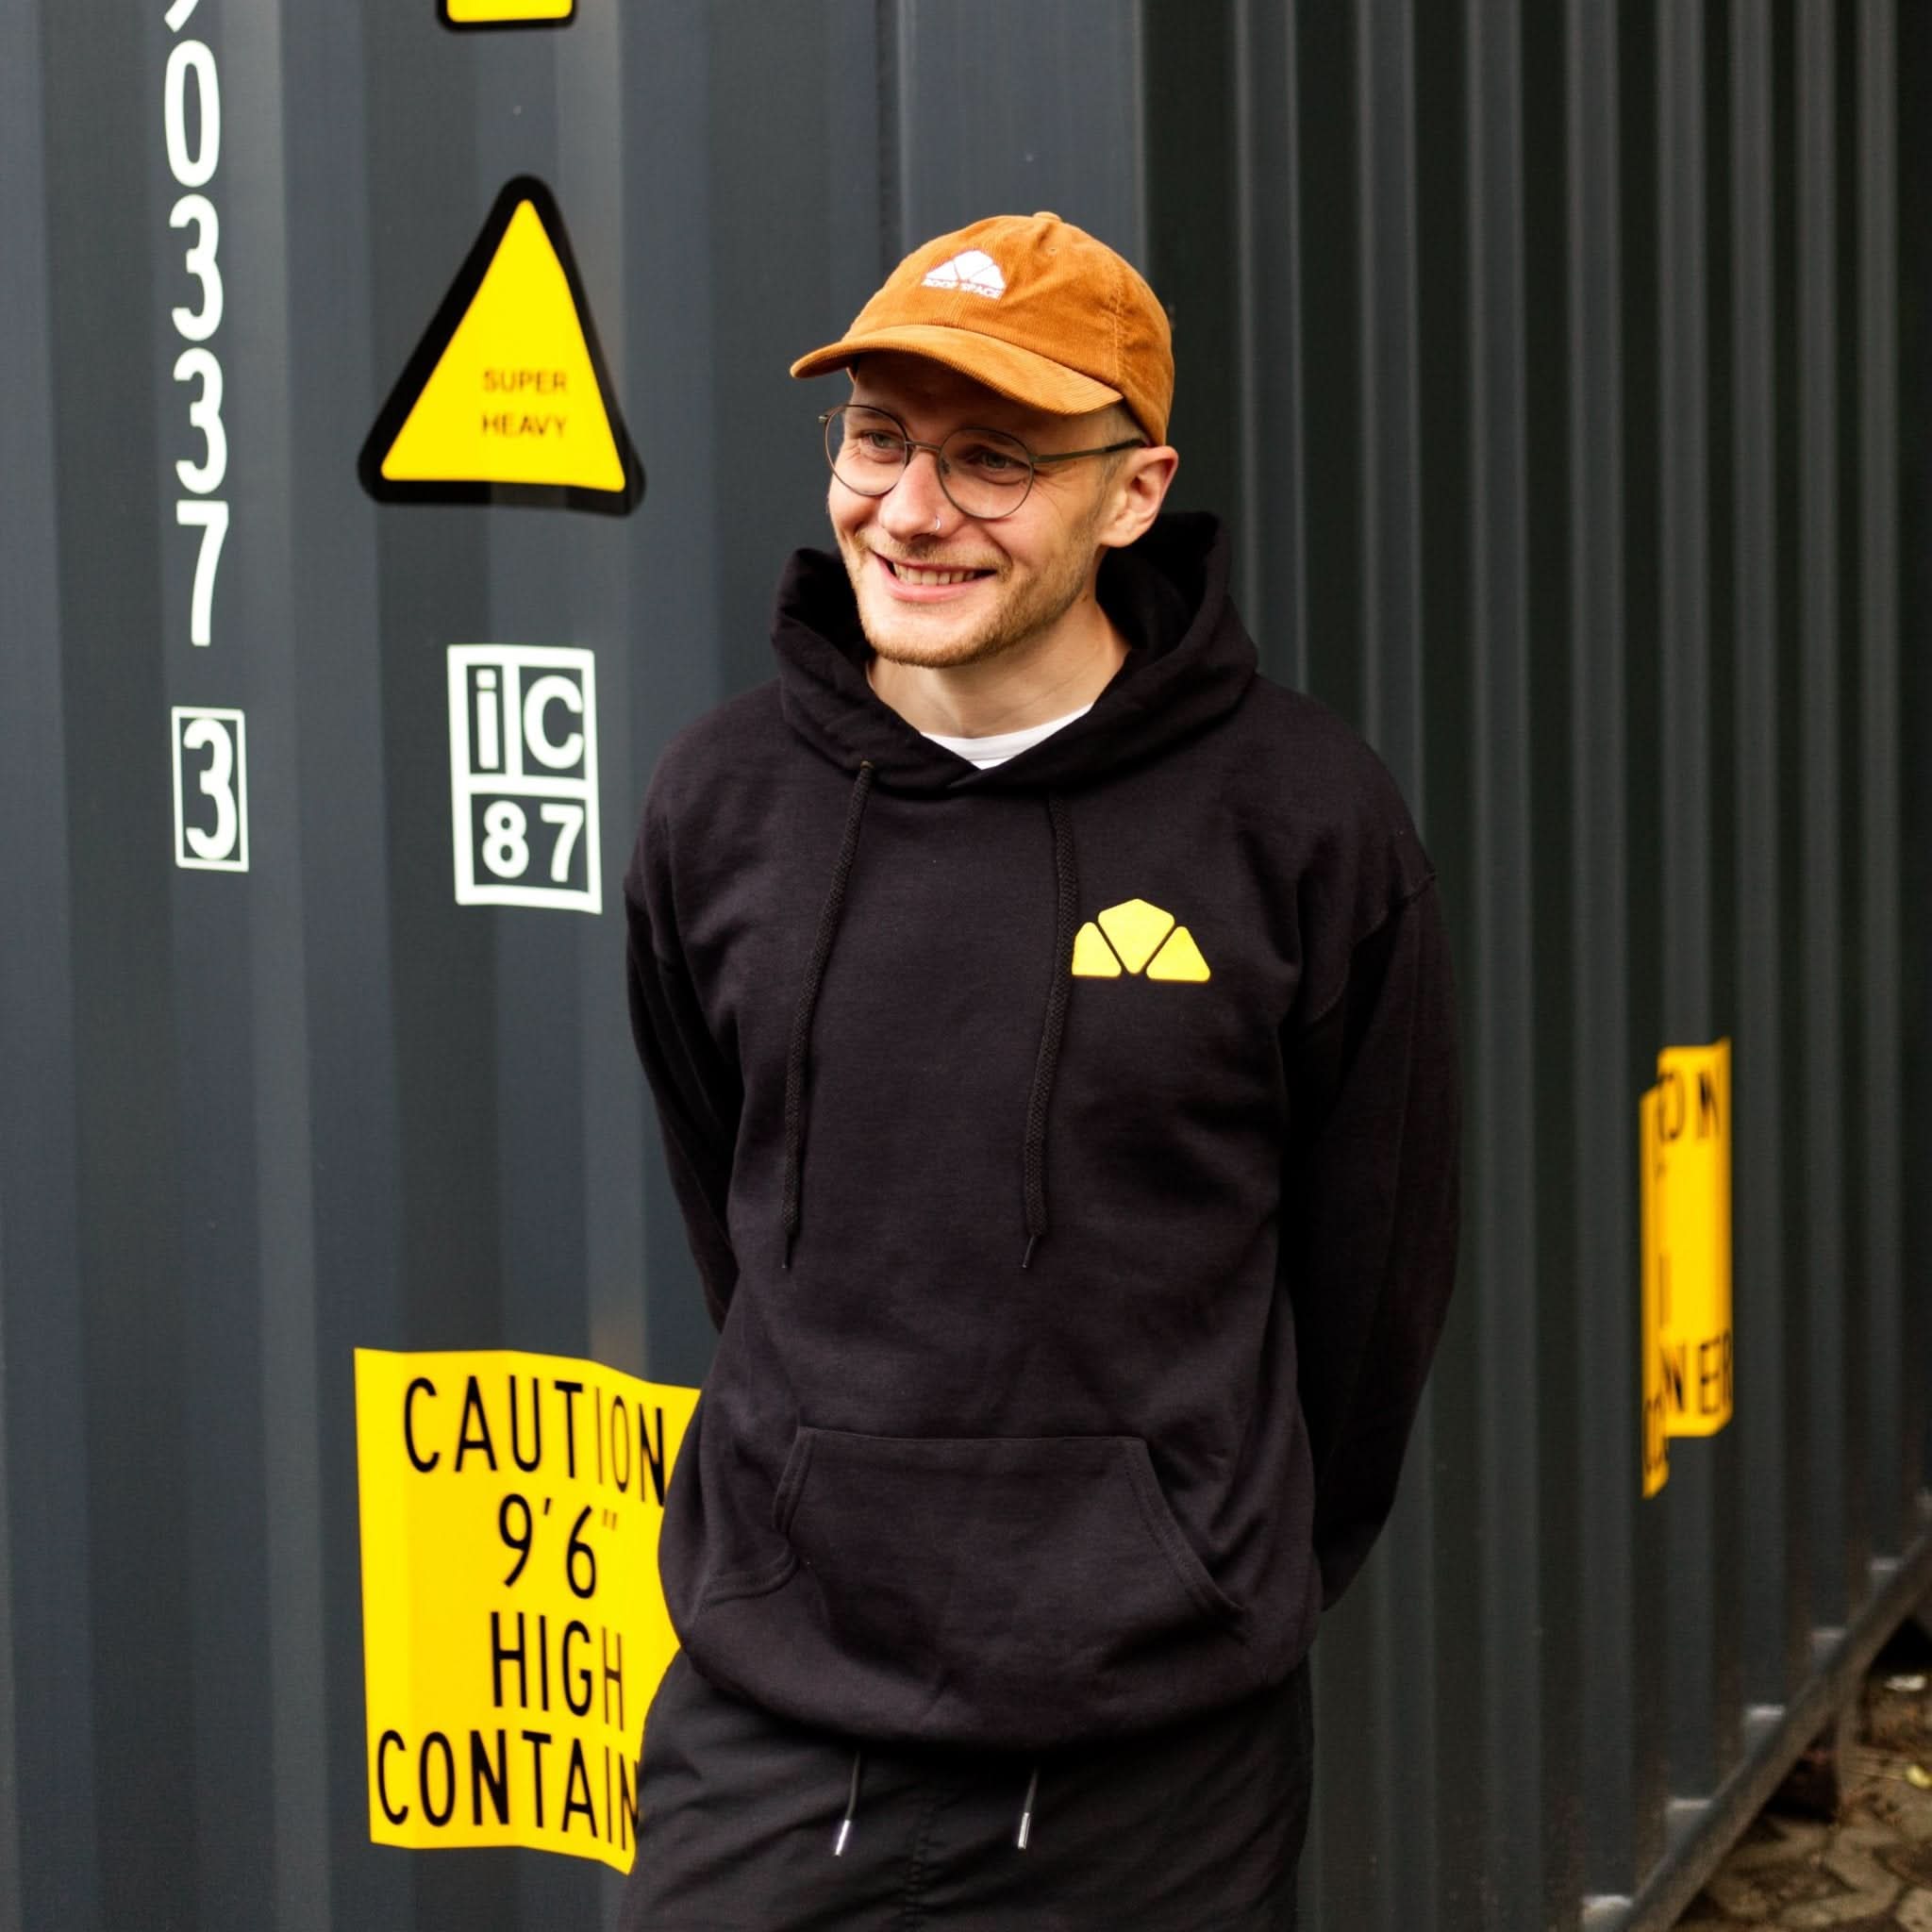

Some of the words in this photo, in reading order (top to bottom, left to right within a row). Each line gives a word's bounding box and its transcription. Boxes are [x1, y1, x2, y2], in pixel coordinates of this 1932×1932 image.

[164, 0, 229, 646] 0337
[482, 369, 566, 392] SUPER
[482, 413, 567, 439] HEAVY
[183, 717, 238, 860] 3
[481, 799, 585, 882] 87
[403, 1374, 665, 1507] CAUTION
[491, 1610, 625, 1732] HIGH
